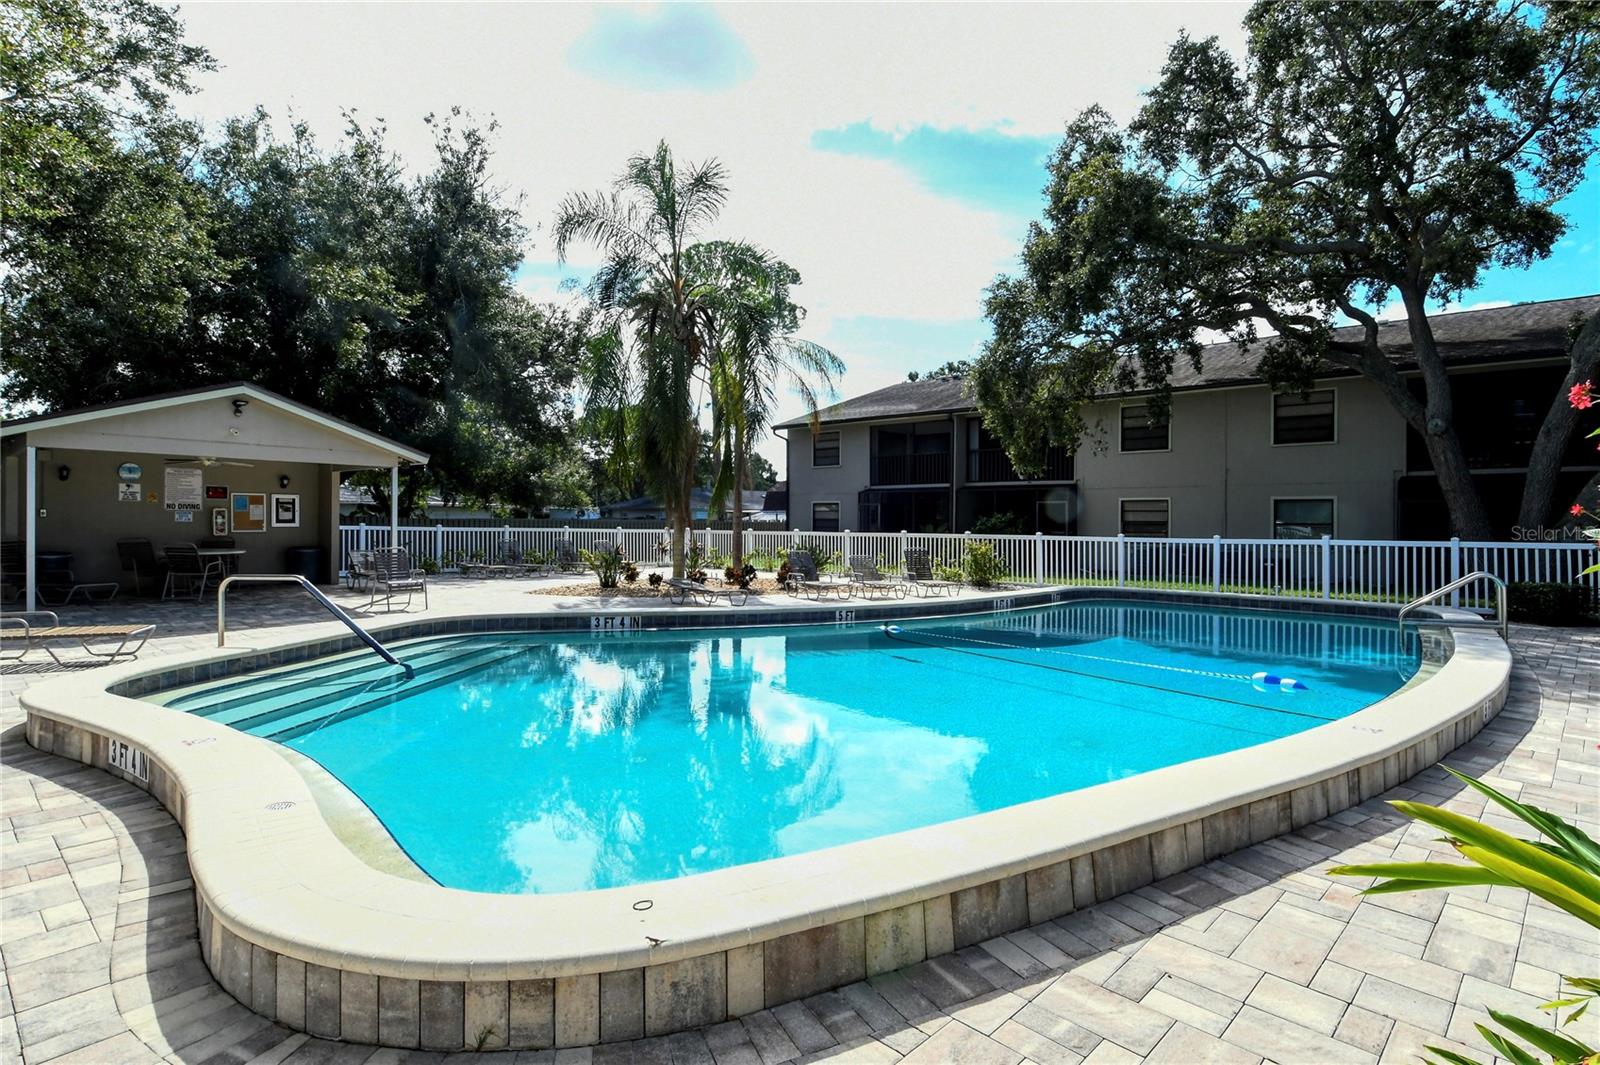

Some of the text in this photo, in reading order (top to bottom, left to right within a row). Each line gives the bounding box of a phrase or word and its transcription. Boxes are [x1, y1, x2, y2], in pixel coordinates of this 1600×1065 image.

[846, 611, 853, 621] FT
[594, 617, 639, 629] 3 FT 4 IN
[112, 739, 147, 780] 3 FT 4 IN
